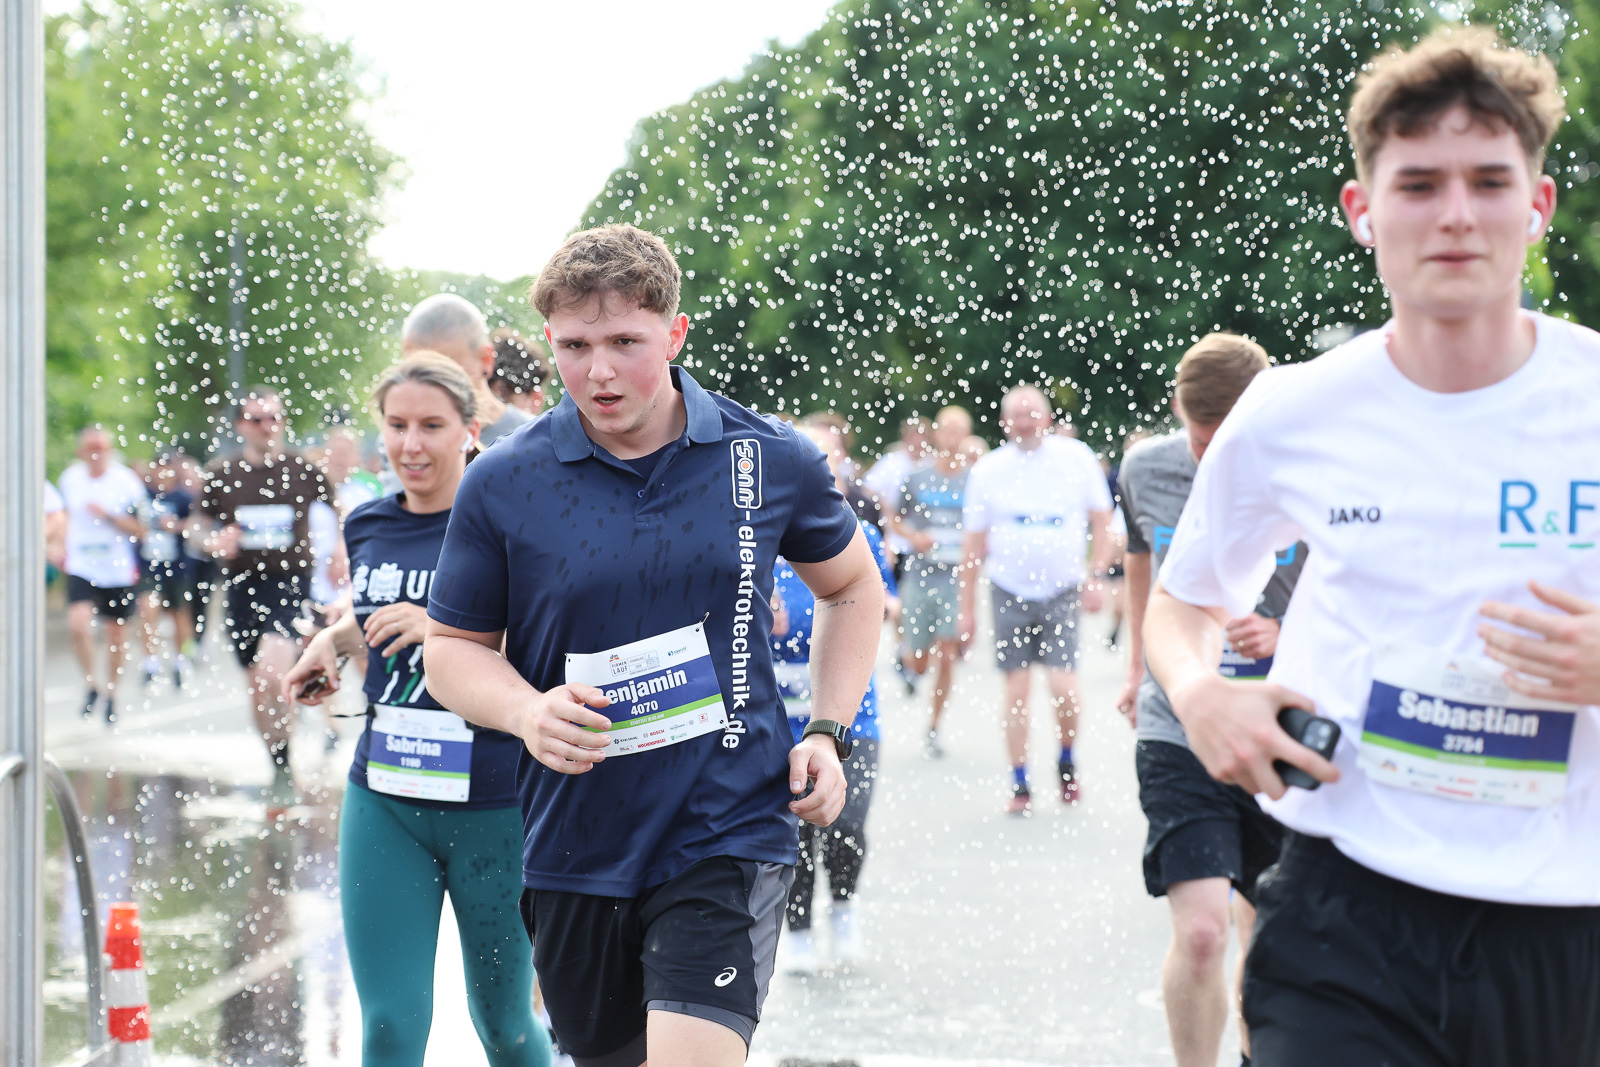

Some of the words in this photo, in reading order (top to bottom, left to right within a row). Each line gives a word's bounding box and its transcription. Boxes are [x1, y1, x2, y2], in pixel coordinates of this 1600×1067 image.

[1328, 507, 1381, 524] JAKO
[612, 666, 628, 675] LAUF
[631, 700, 659, 716] 4070
[1398, 690, 1539, 737] Sebastian
[649, 729, 665, 737] BOSCH
[385, 734, 442, 757] Sabrina
